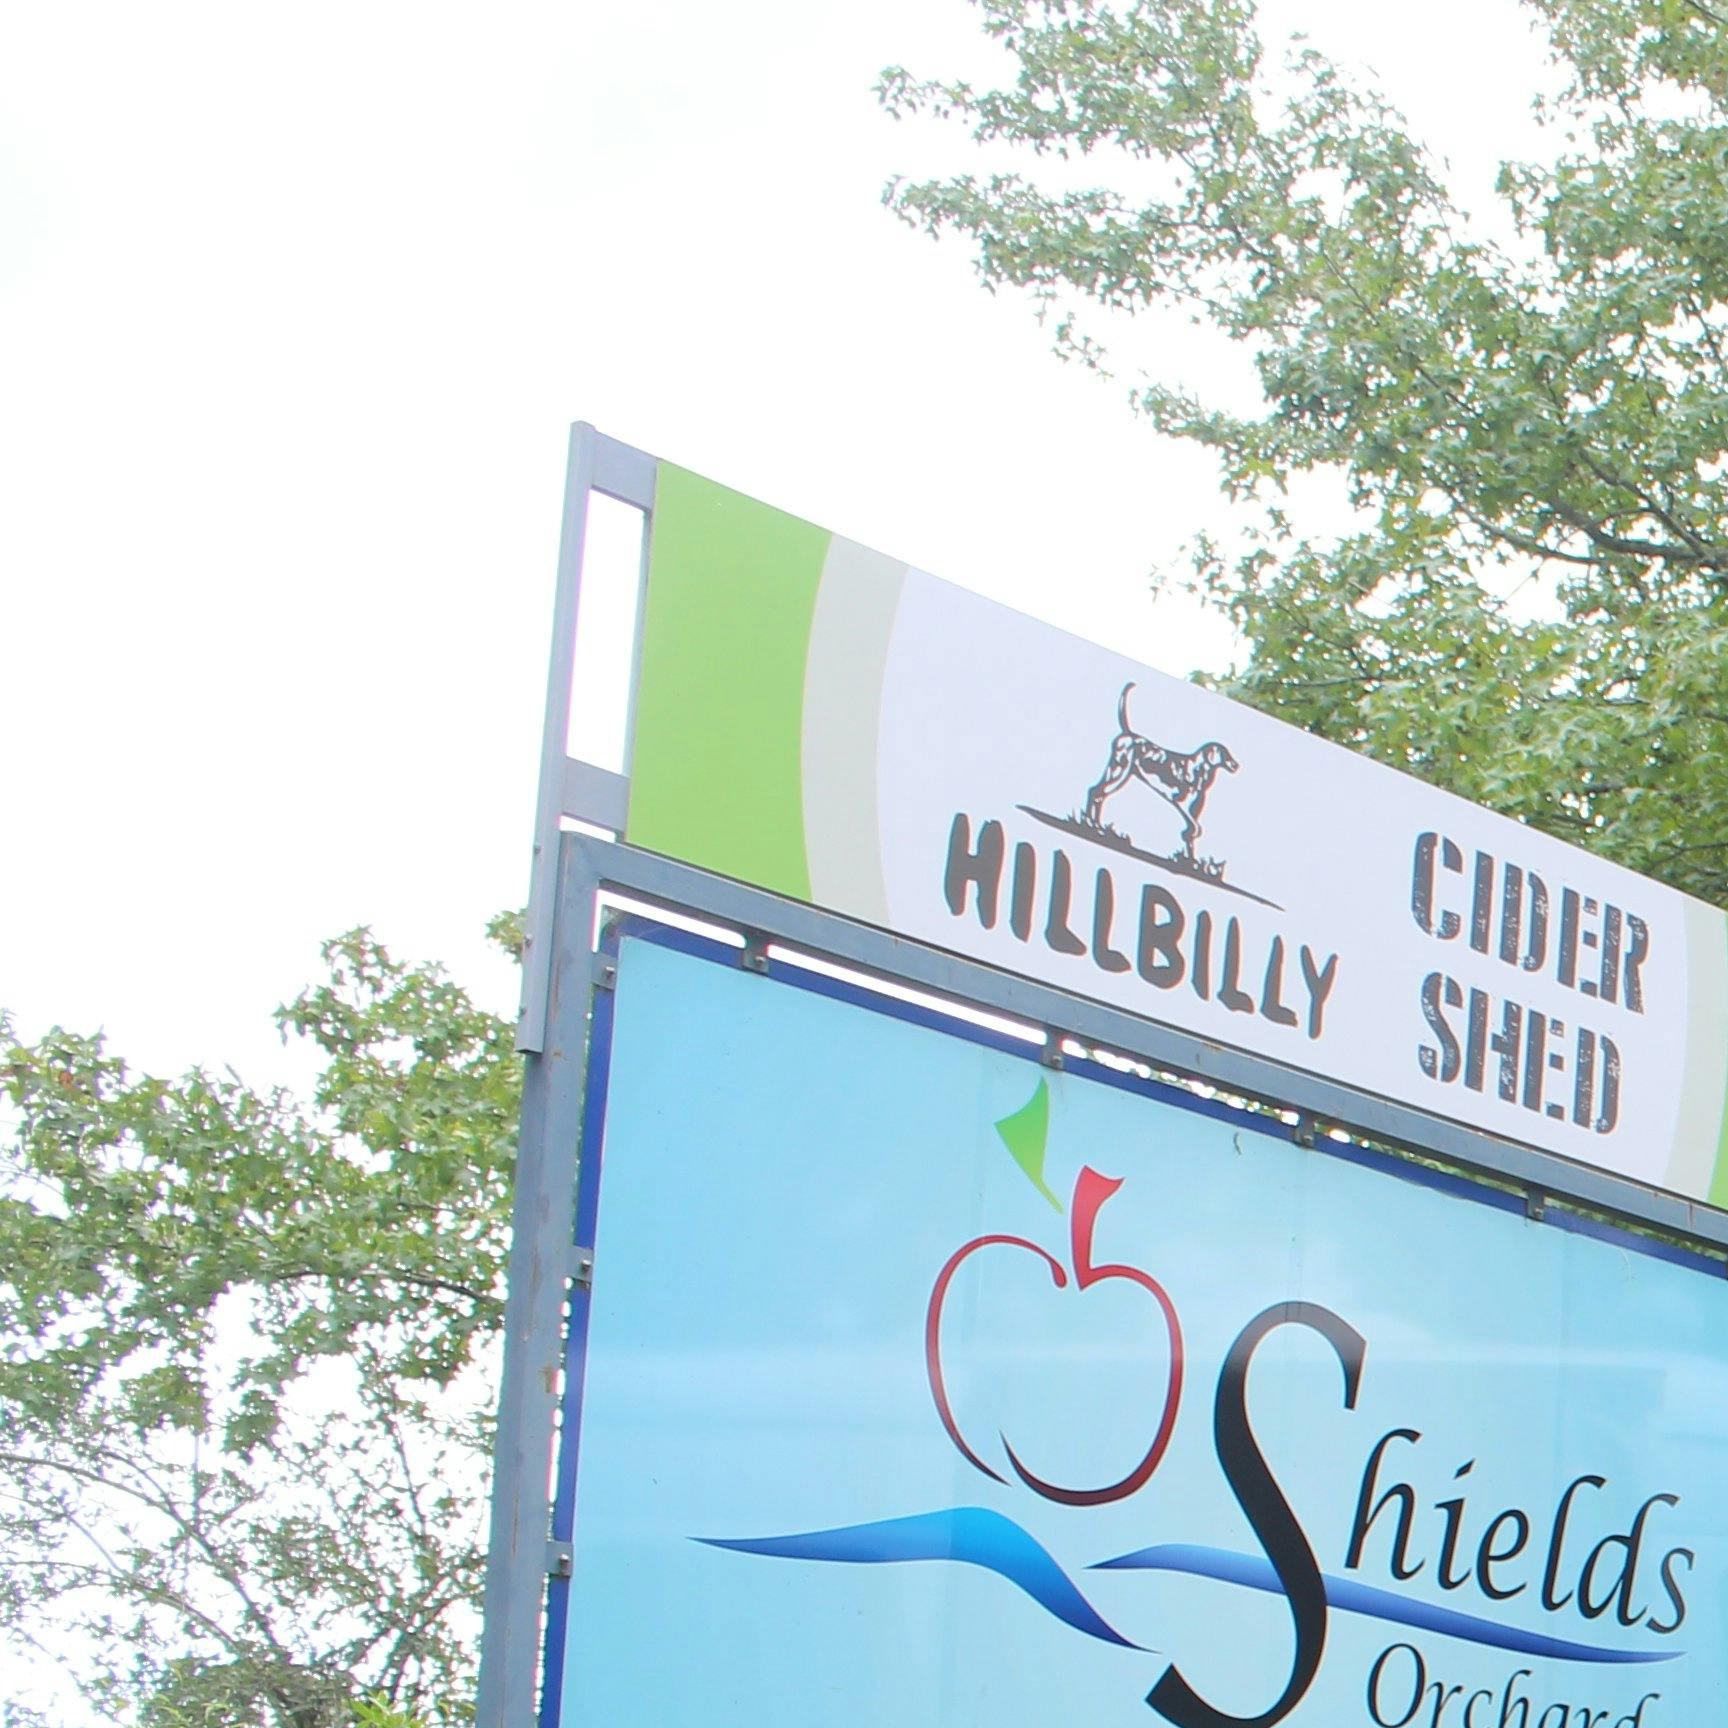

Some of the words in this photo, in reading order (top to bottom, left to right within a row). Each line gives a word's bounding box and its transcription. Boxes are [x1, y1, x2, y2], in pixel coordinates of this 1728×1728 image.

[943, 812, 1340, 1040] HILLBILLY
[1412, 830, 1651, 1014] CIDER
[1418, 973, 1624, 1135] SHED
